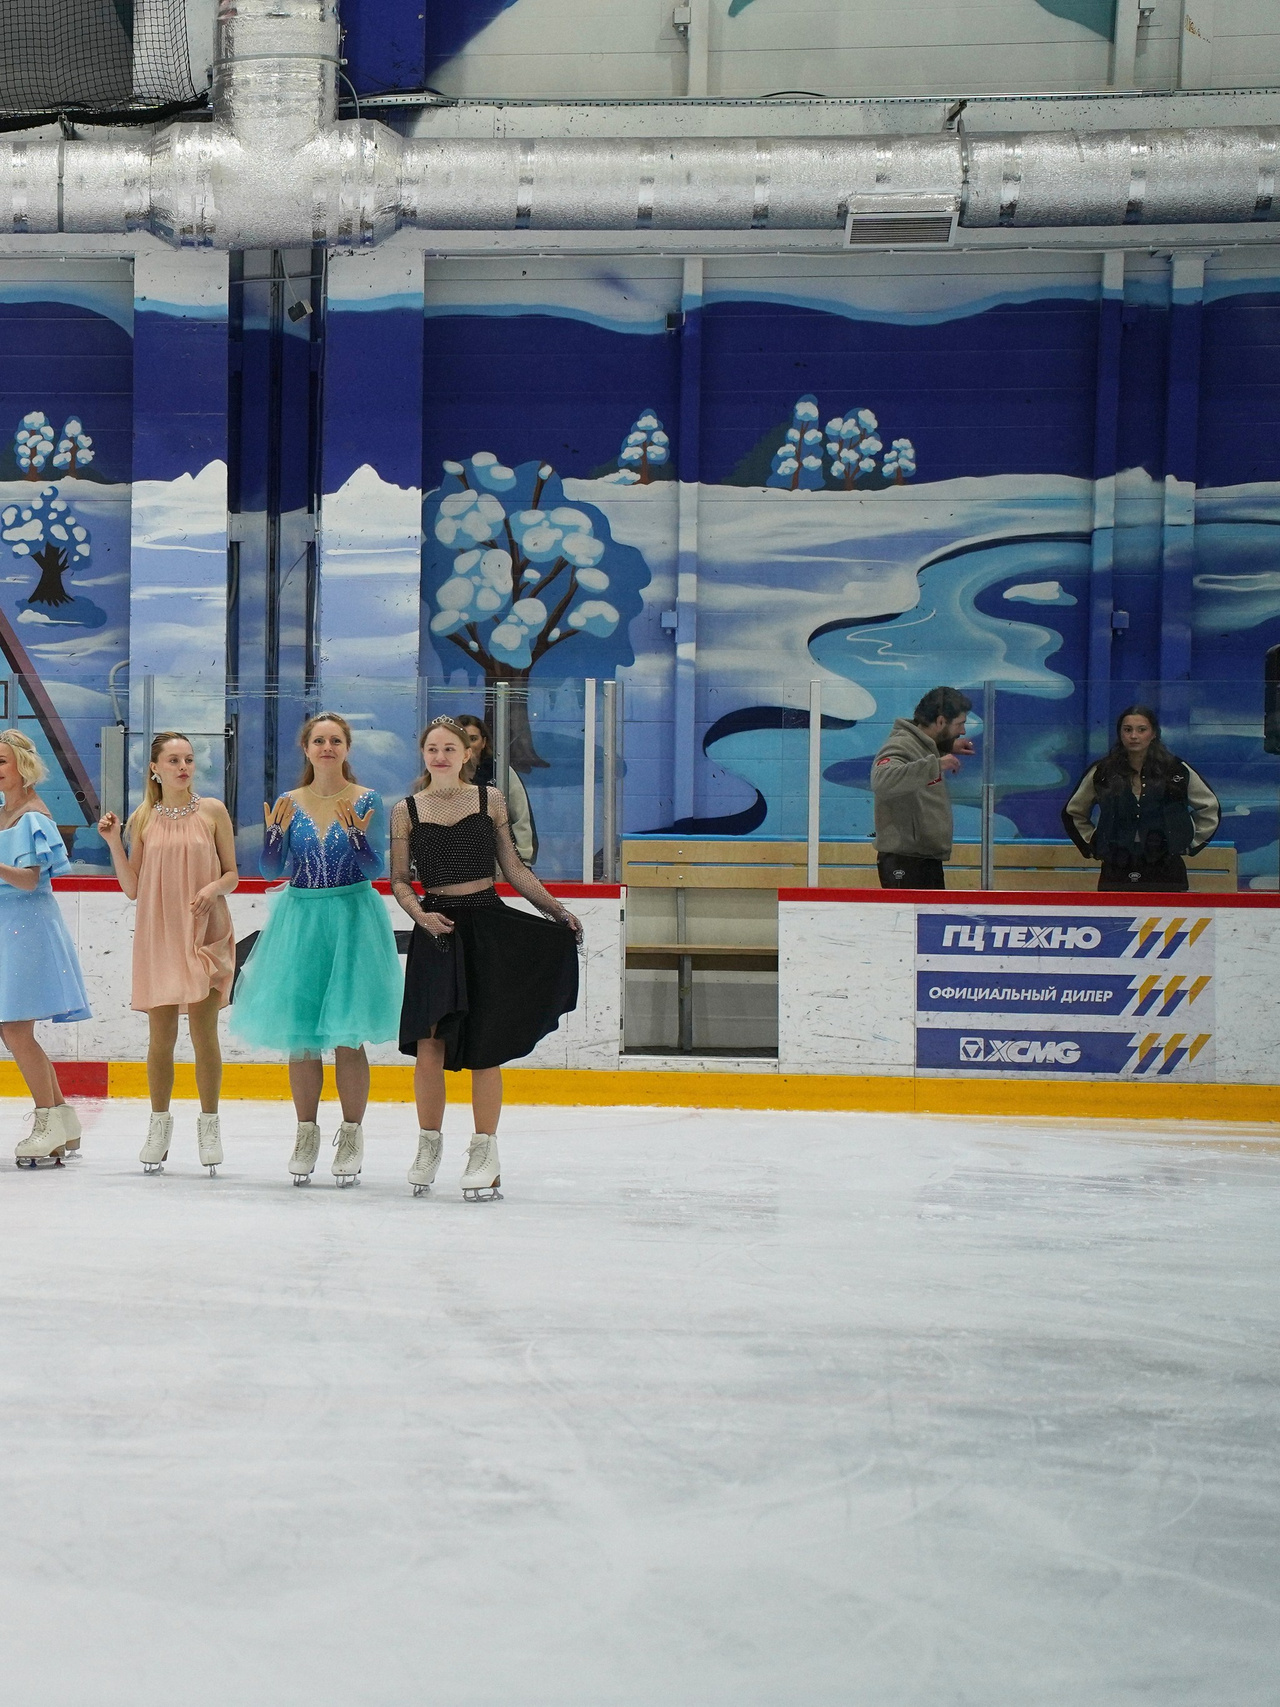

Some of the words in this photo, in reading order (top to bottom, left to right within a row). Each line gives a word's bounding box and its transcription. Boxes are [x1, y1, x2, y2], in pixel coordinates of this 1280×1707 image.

[942, 925, 986, 951] ГЦ
[991, 926, 1102, 949] ТЕХНО
[928, 986, 1057, 1001] ОФИЦИАЛЬНЫЙ
[1060, 990, 1113, 1003] ДИЛЕР
[983, 1040, 1082, 1064] XCMG
